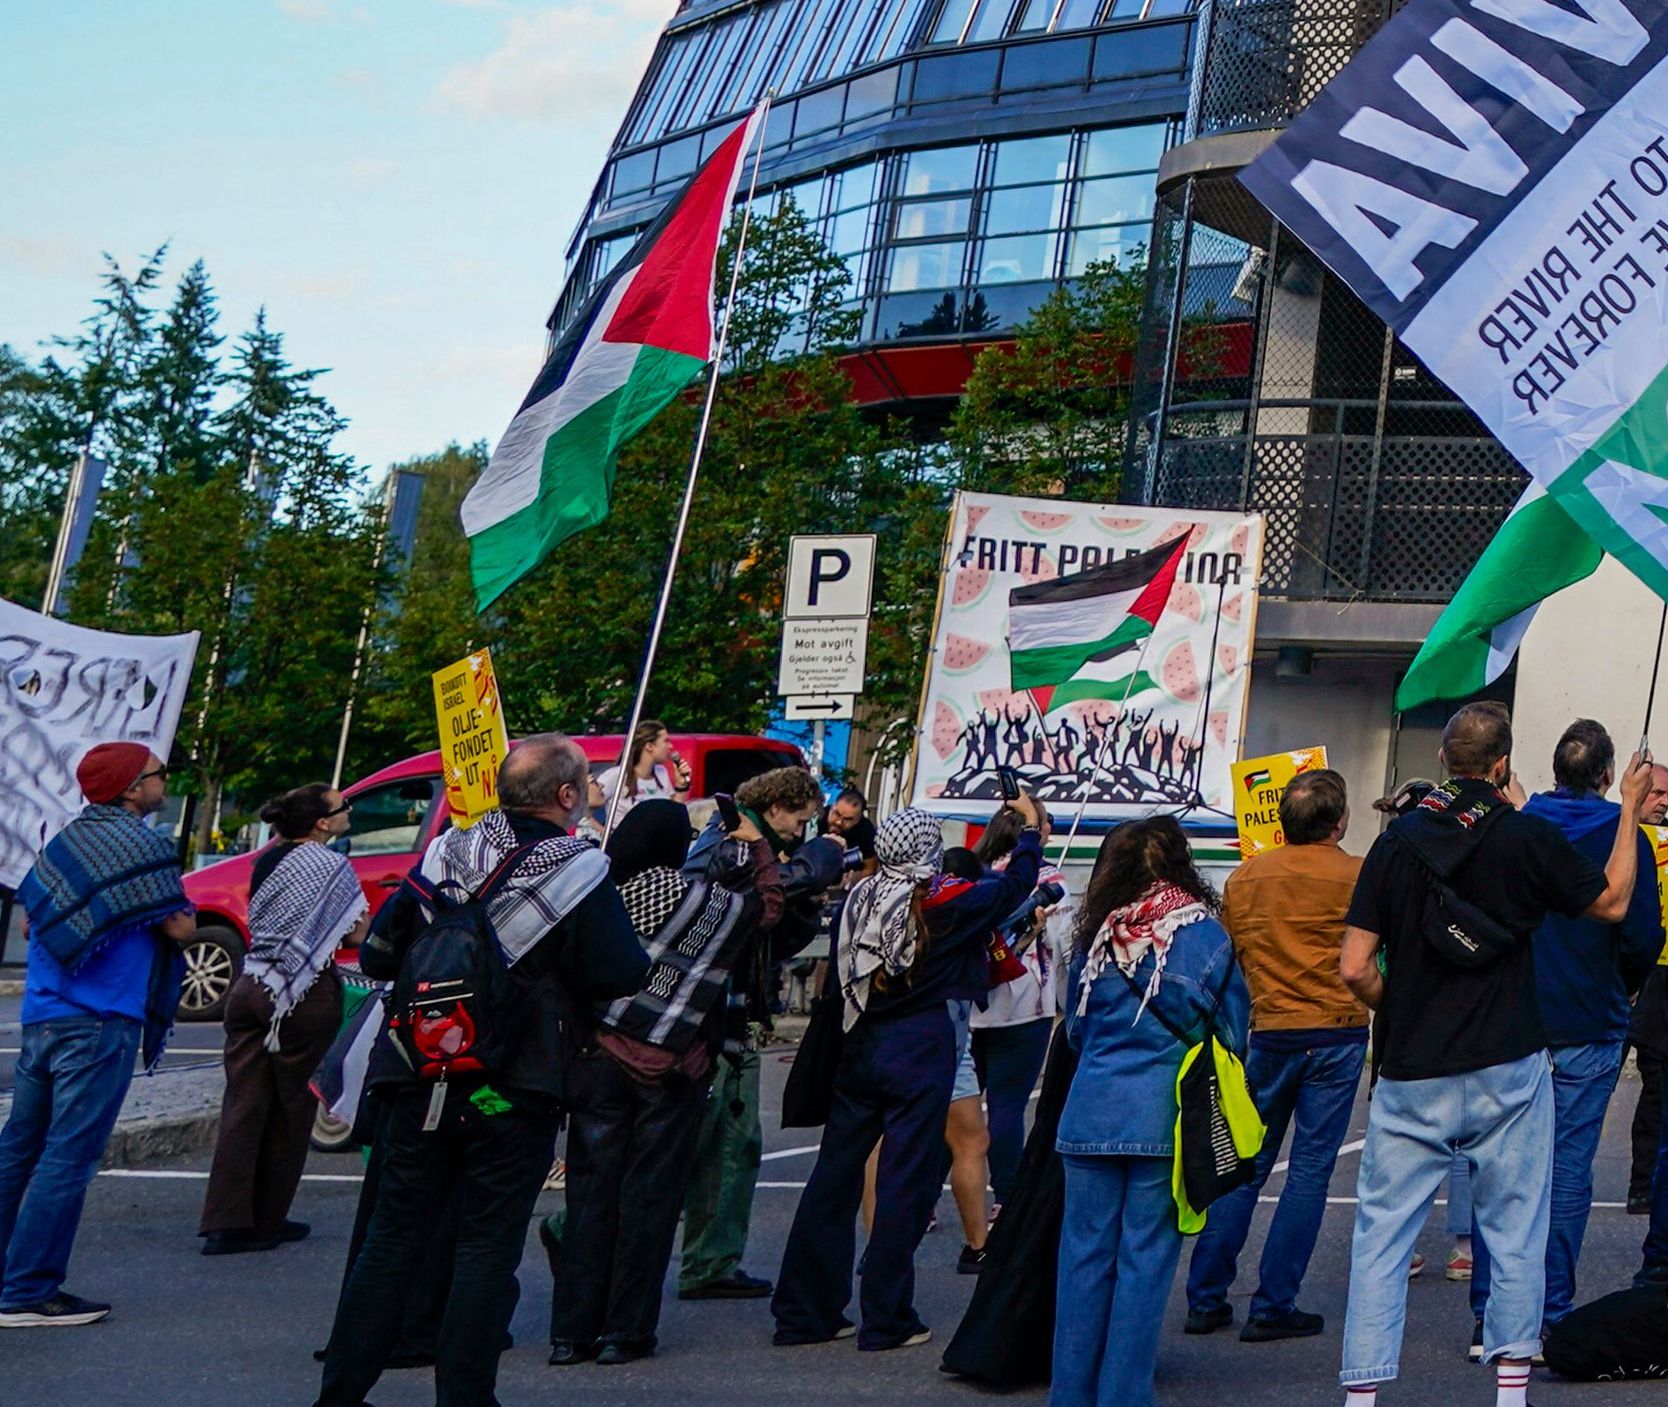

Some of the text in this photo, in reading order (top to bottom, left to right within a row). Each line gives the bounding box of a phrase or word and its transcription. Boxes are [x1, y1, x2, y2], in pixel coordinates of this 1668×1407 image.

[960, 535, 1047, 575] FRITT
[807, 548, 852, 606] P
[794, 638, 854, 650] Mot avgift
[788, 655, 819, 665] Gjelder
[452, 707, 482, 737] OLJE-
[453, 728, 493, 764] FONDET
[465, 762, 480, 786] UT
